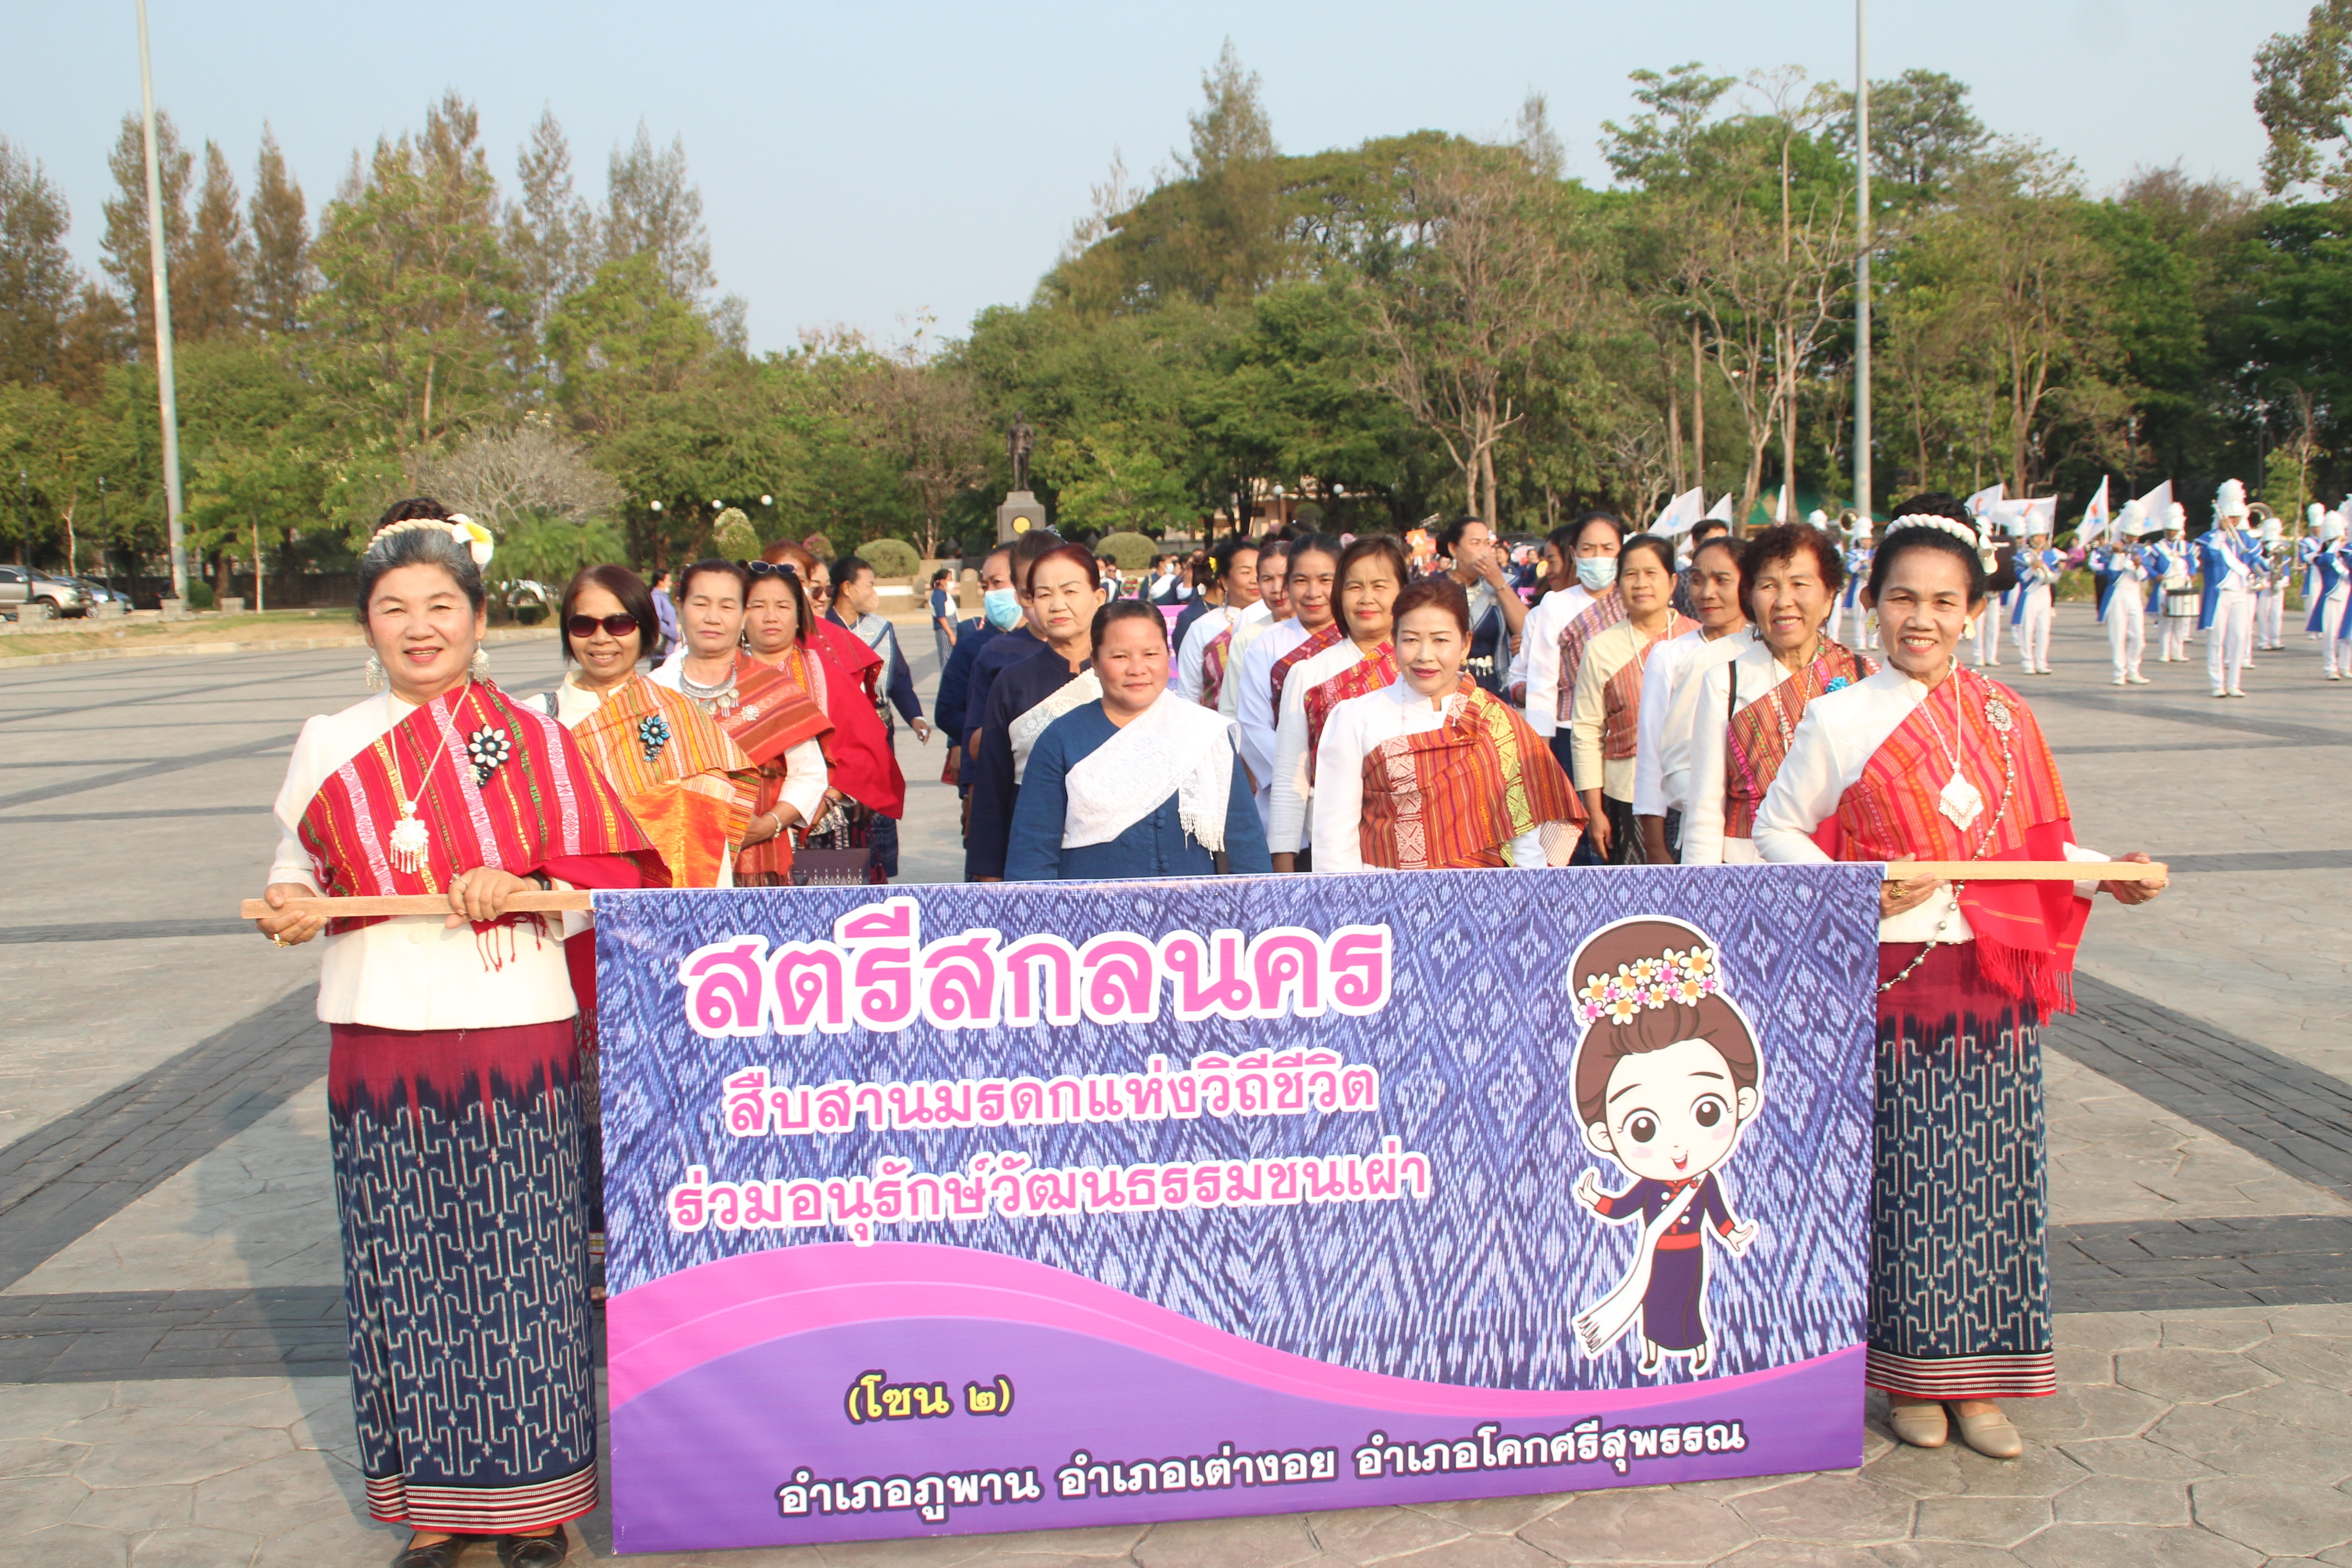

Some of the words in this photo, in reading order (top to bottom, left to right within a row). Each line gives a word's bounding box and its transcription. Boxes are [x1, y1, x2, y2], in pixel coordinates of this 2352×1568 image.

[686, 904, 1385, 1029] สตรีสกลนคร
[728, 1052, 1374, 1131] สืบสานมรดกแห่งวิถีชีวิต
[674, 1140, 1425, 1241] ร่วมอนุรักษ์วัฒนธรรมชนเผ่า
[848, 1374, 950, 1421] (โซน
[968, 1379, 1010, 1412] ๒)
[779, 1470, 1040, 1521] อำเภอภูพาน
[1058, 1445, 1335, 1496] อำเภอเต่างอย
[1355, 1420, 1745, 1475] อำเภอโคกศรีสุพรรณ
